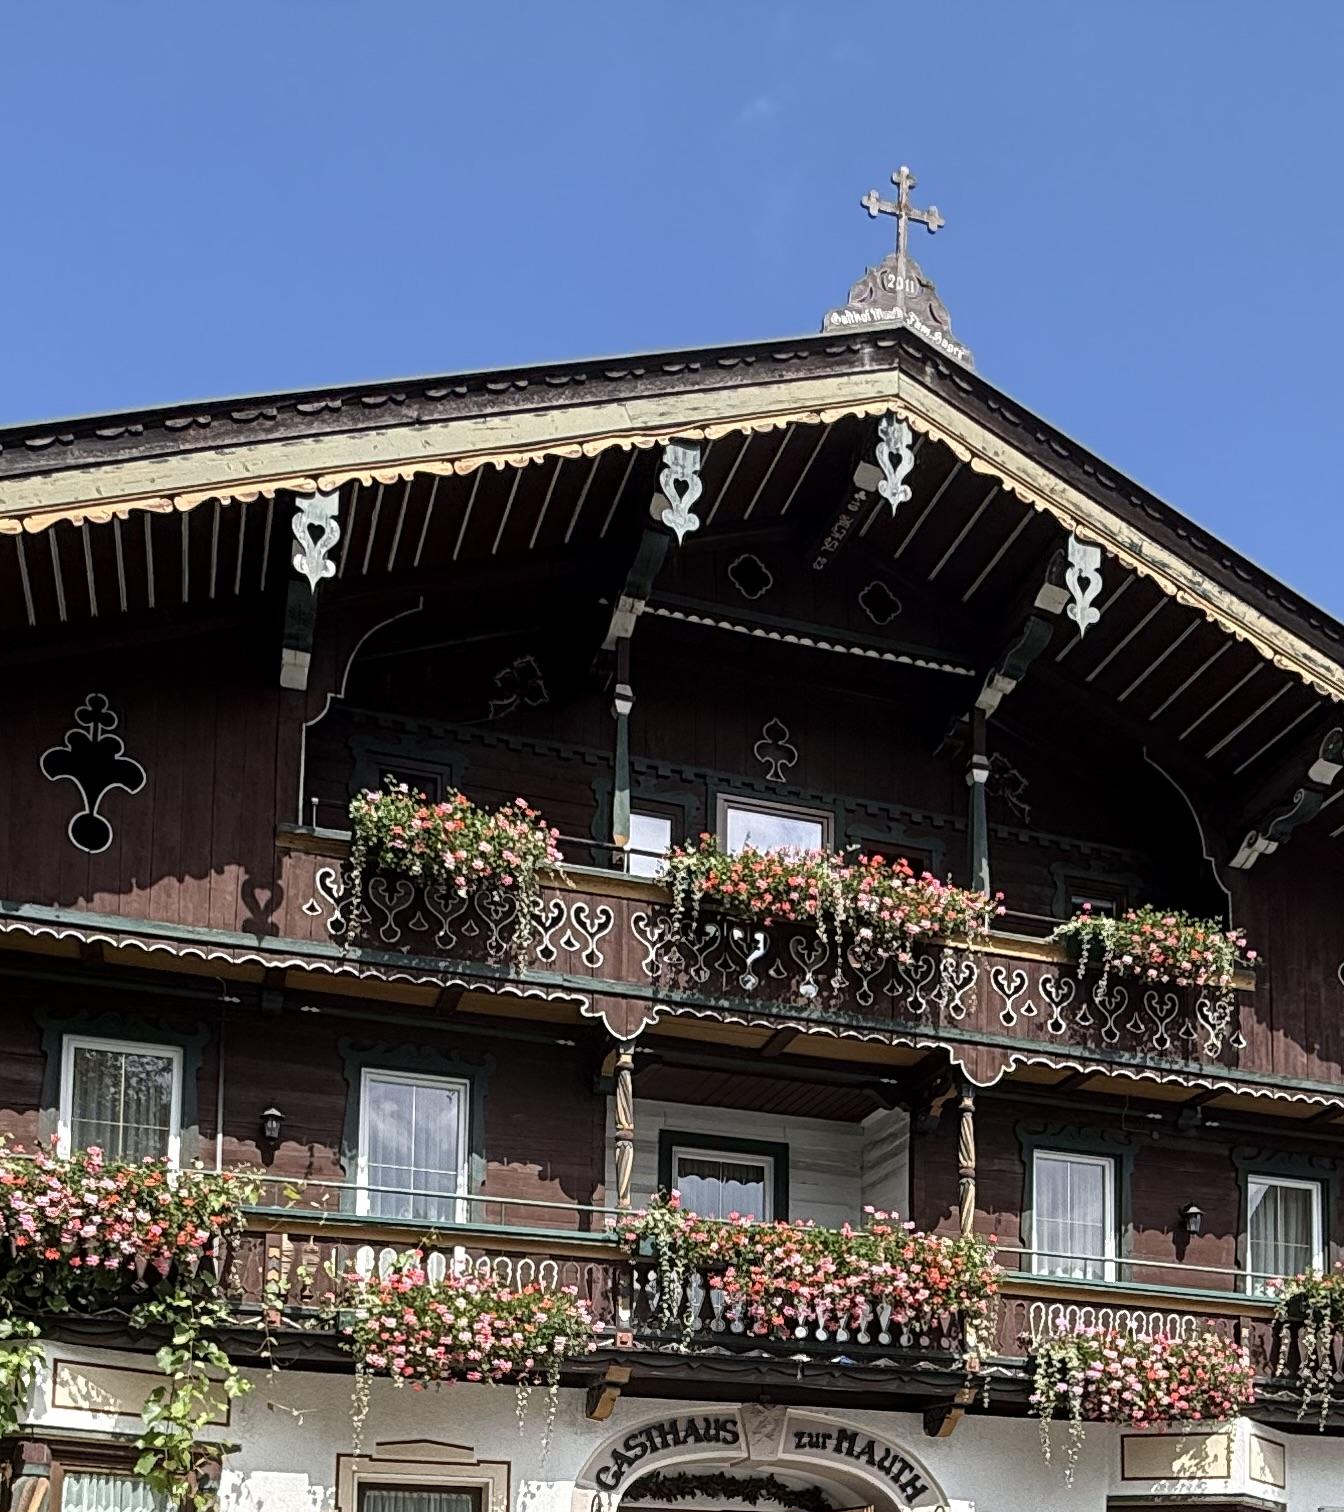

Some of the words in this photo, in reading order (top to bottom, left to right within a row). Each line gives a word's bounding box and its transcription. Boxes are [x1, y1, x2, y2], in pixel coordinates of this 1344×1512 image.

[887, 274, 915, 293] 2011
[595, 1417, 740, 1491] GASTHAUS
[793, 1429, 832, 1450] zur
[832, 1428, 930, 1503] MAUTH
